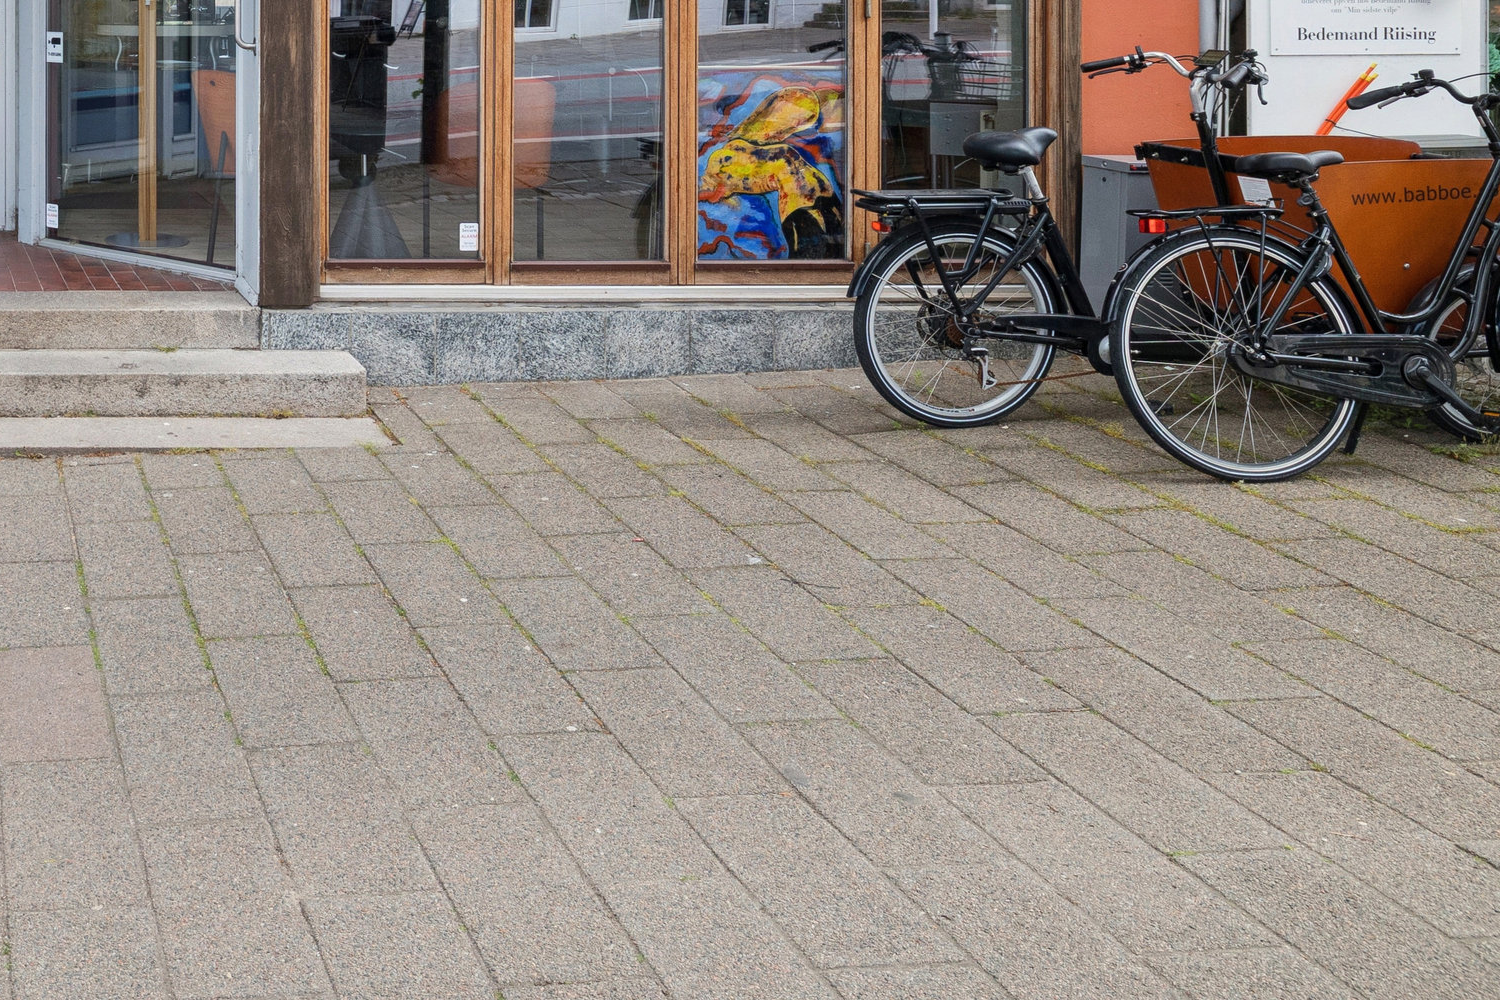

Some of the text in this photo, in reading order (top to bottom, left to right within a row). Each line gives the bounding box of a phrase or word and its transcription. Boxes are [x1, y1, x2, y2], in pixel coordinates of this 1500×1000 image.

[1297, 27, 1437, 44] Bedemand Riising
[1352, 184, 1477, 205] www.babboe.
